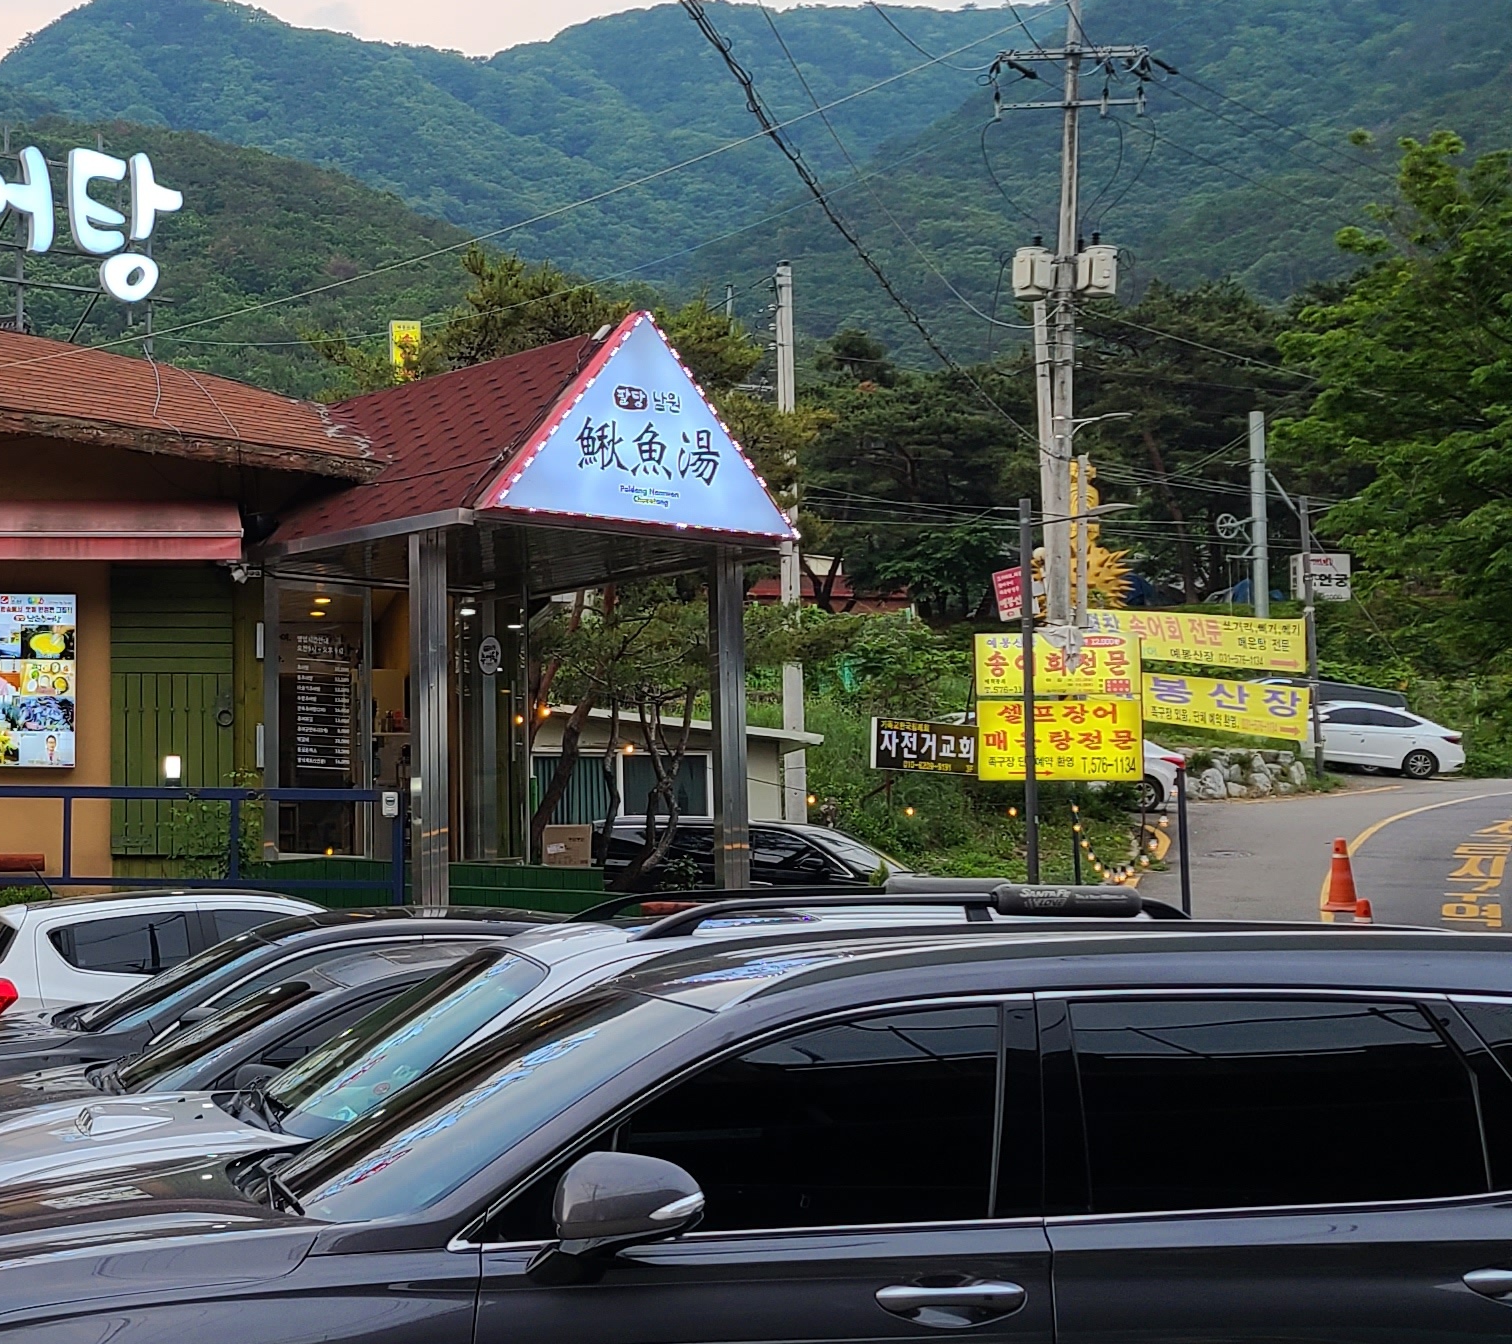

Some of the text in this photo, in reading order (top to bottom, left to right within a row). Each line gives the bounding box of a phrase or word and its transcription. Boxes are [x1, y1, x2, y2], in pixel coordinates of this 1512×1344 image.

[616, 388, 681, 414] 팔당 남원
[575, 416, 721, 486] 鰍魚湯
[1129, 614, 1184, 644] 송어회
[1188, 617, 1223, 647] 전문
[986, 637, 1036, 649] 예봉산
[1272, 638, 1290, 653] 전문
[997, 702, 1118, 725] 셀프장어
[879, 729, 975, 764] 자전거교회
[988, 756, 1015, 768] 족구장
